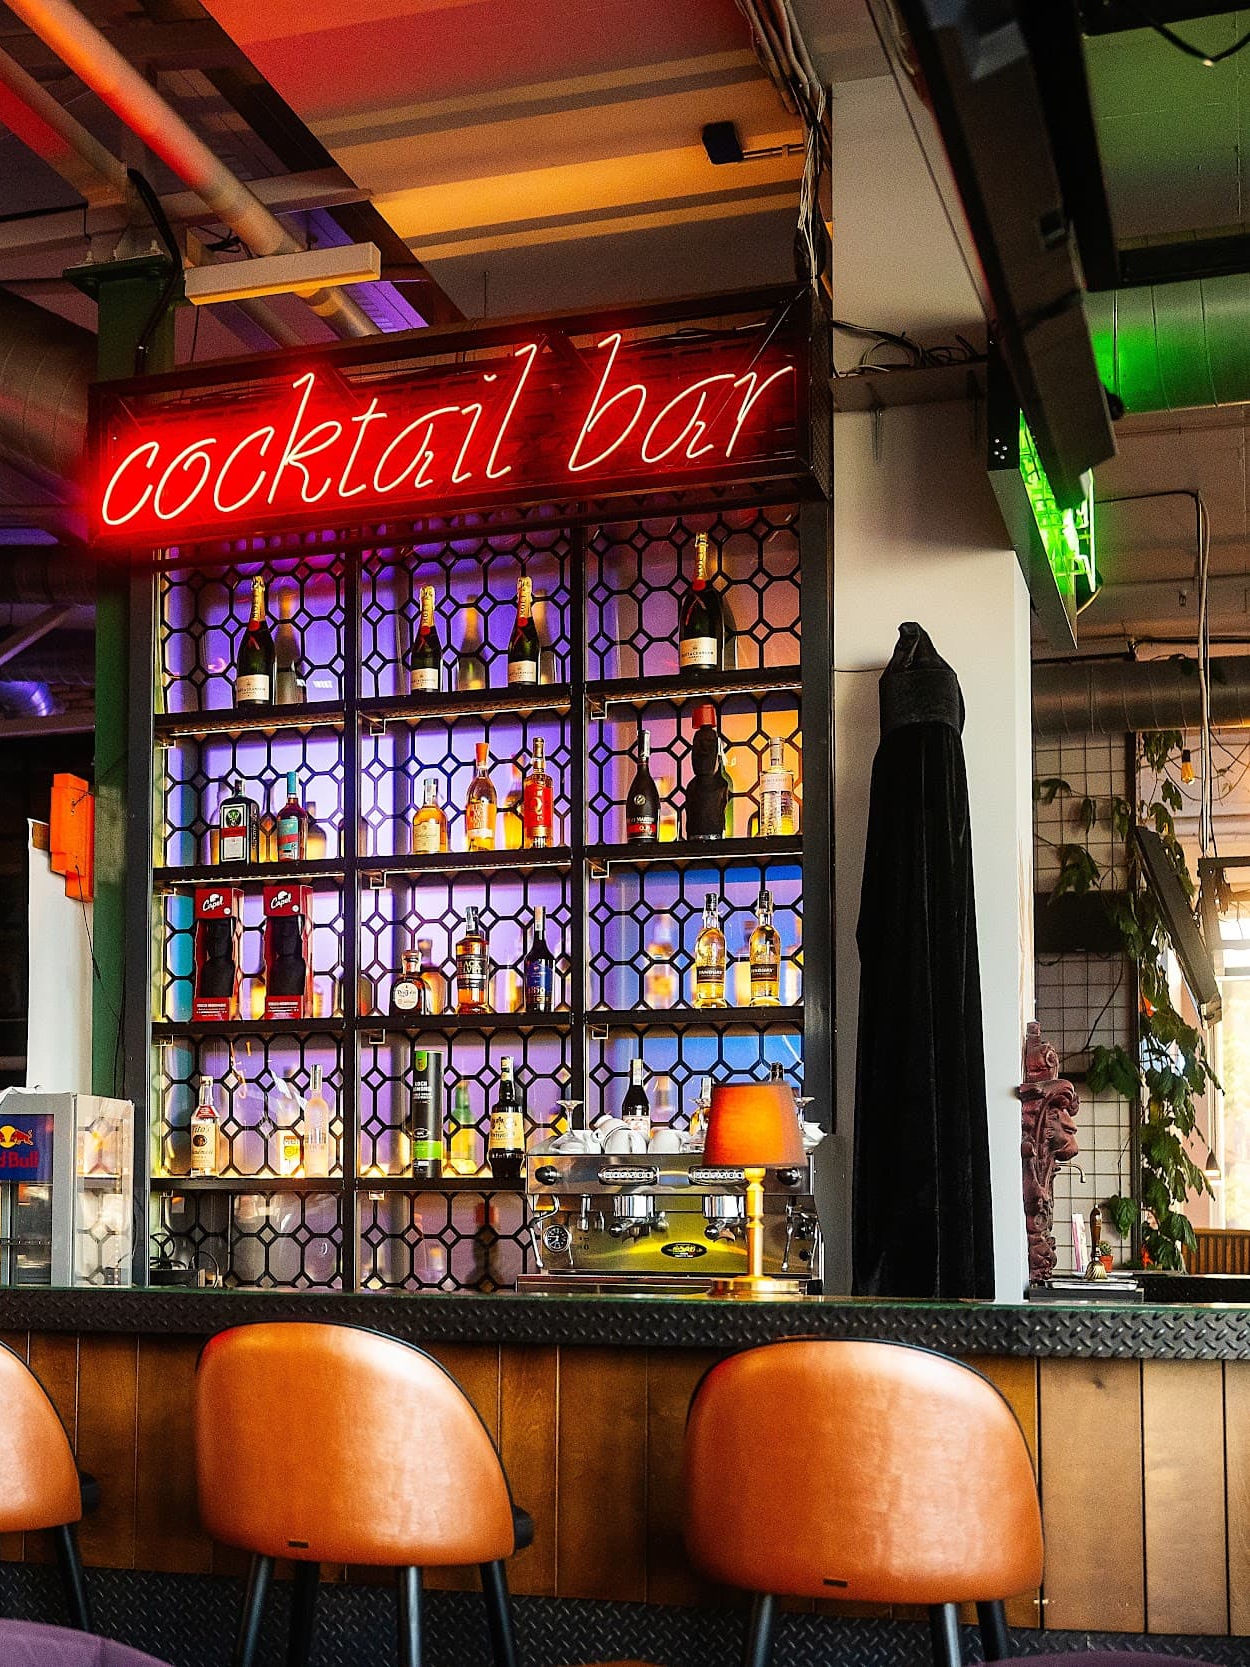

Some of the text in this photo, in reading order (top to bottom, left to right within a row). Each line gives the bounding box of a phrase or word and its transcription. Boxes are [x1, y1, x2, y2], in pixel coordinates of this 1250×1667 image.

[102, 333, 795, 526] cocktail bar
[203, 895, 225, 911] Capel
[271, 892, 292, 909] Capel
[8, 1150, 39, 1168] Bull
